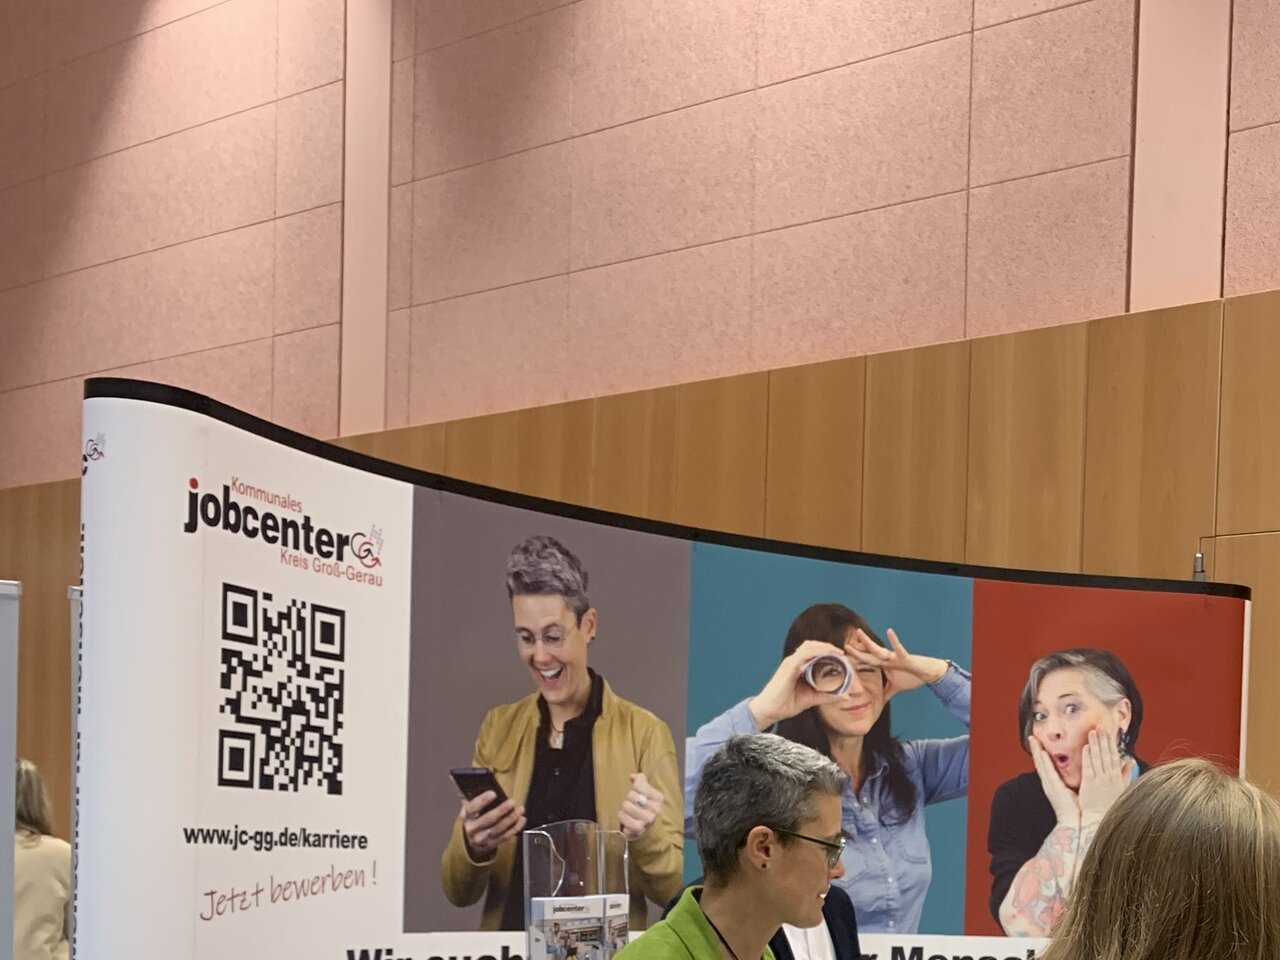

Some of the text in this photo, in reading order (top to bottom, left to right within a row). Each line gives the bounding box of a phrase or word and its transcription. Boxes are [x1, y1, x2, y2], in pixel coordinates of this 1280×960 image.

[231, 476, 303, 513] Kommunales
[184, 477, 350, 562] jobcenter
[280, 549, 383, 587] Kreis Groß-Gerau
[183, 825, 368, 851] www.jc-gg.de/karriere
[199, 860, 377, 921] Jetzt bewerben !
